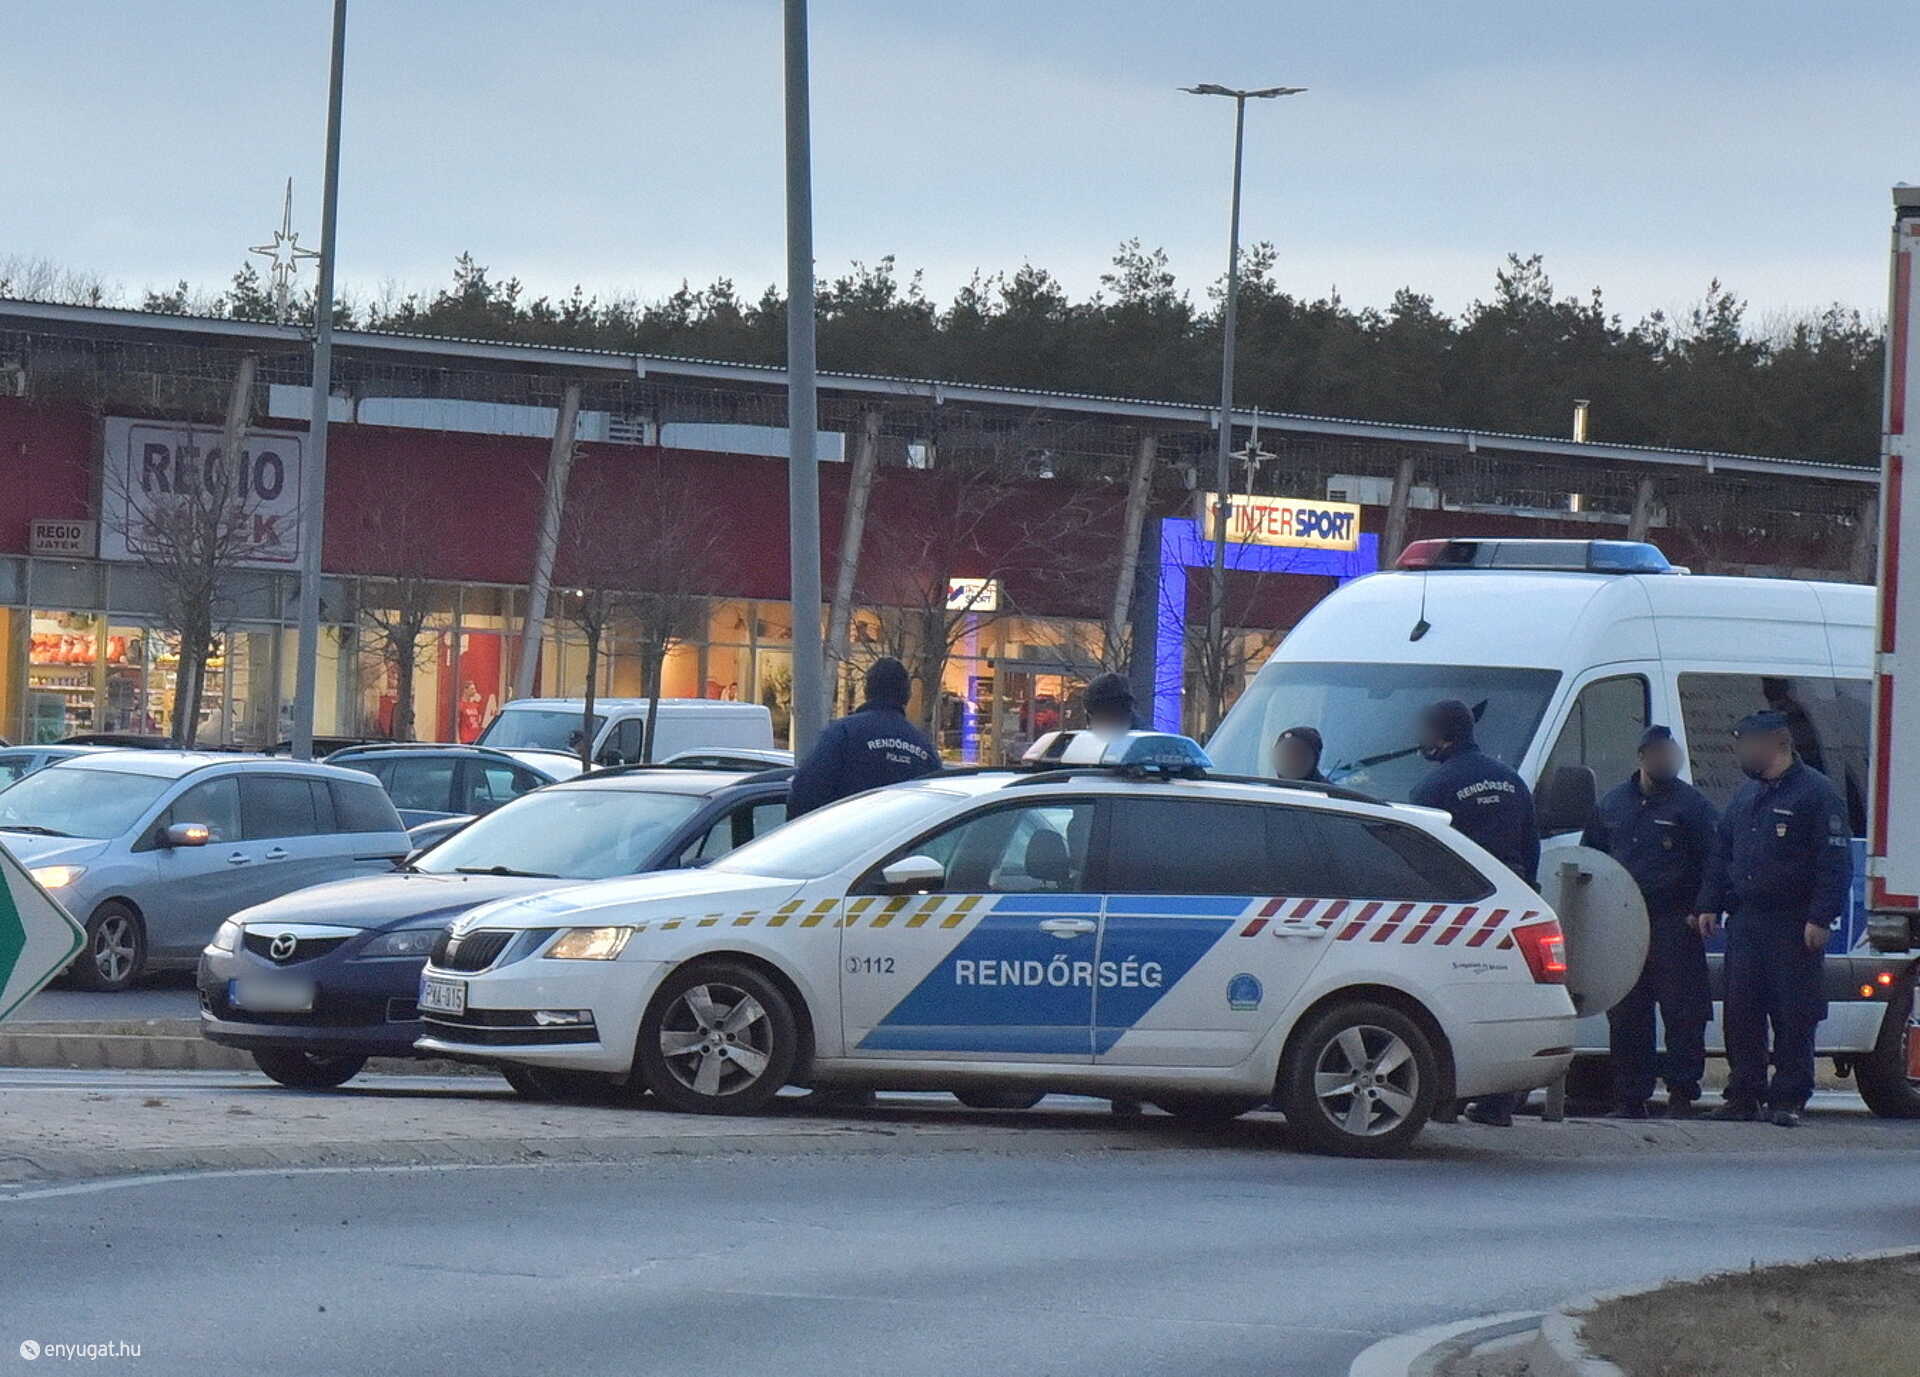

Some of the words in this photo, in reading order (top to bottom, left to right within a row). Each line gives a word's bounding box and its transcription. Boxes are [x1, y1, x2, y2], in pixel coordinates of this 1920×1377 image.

[141, 443, 285, 501] REGIO
[36, 526, 81, 539] REGIO
[1234, 504, 1354, 541] INTERSPORT
[863, 957, 895, 974] 112
[955, 954, 1163, 988] RENDŐRSÉG
